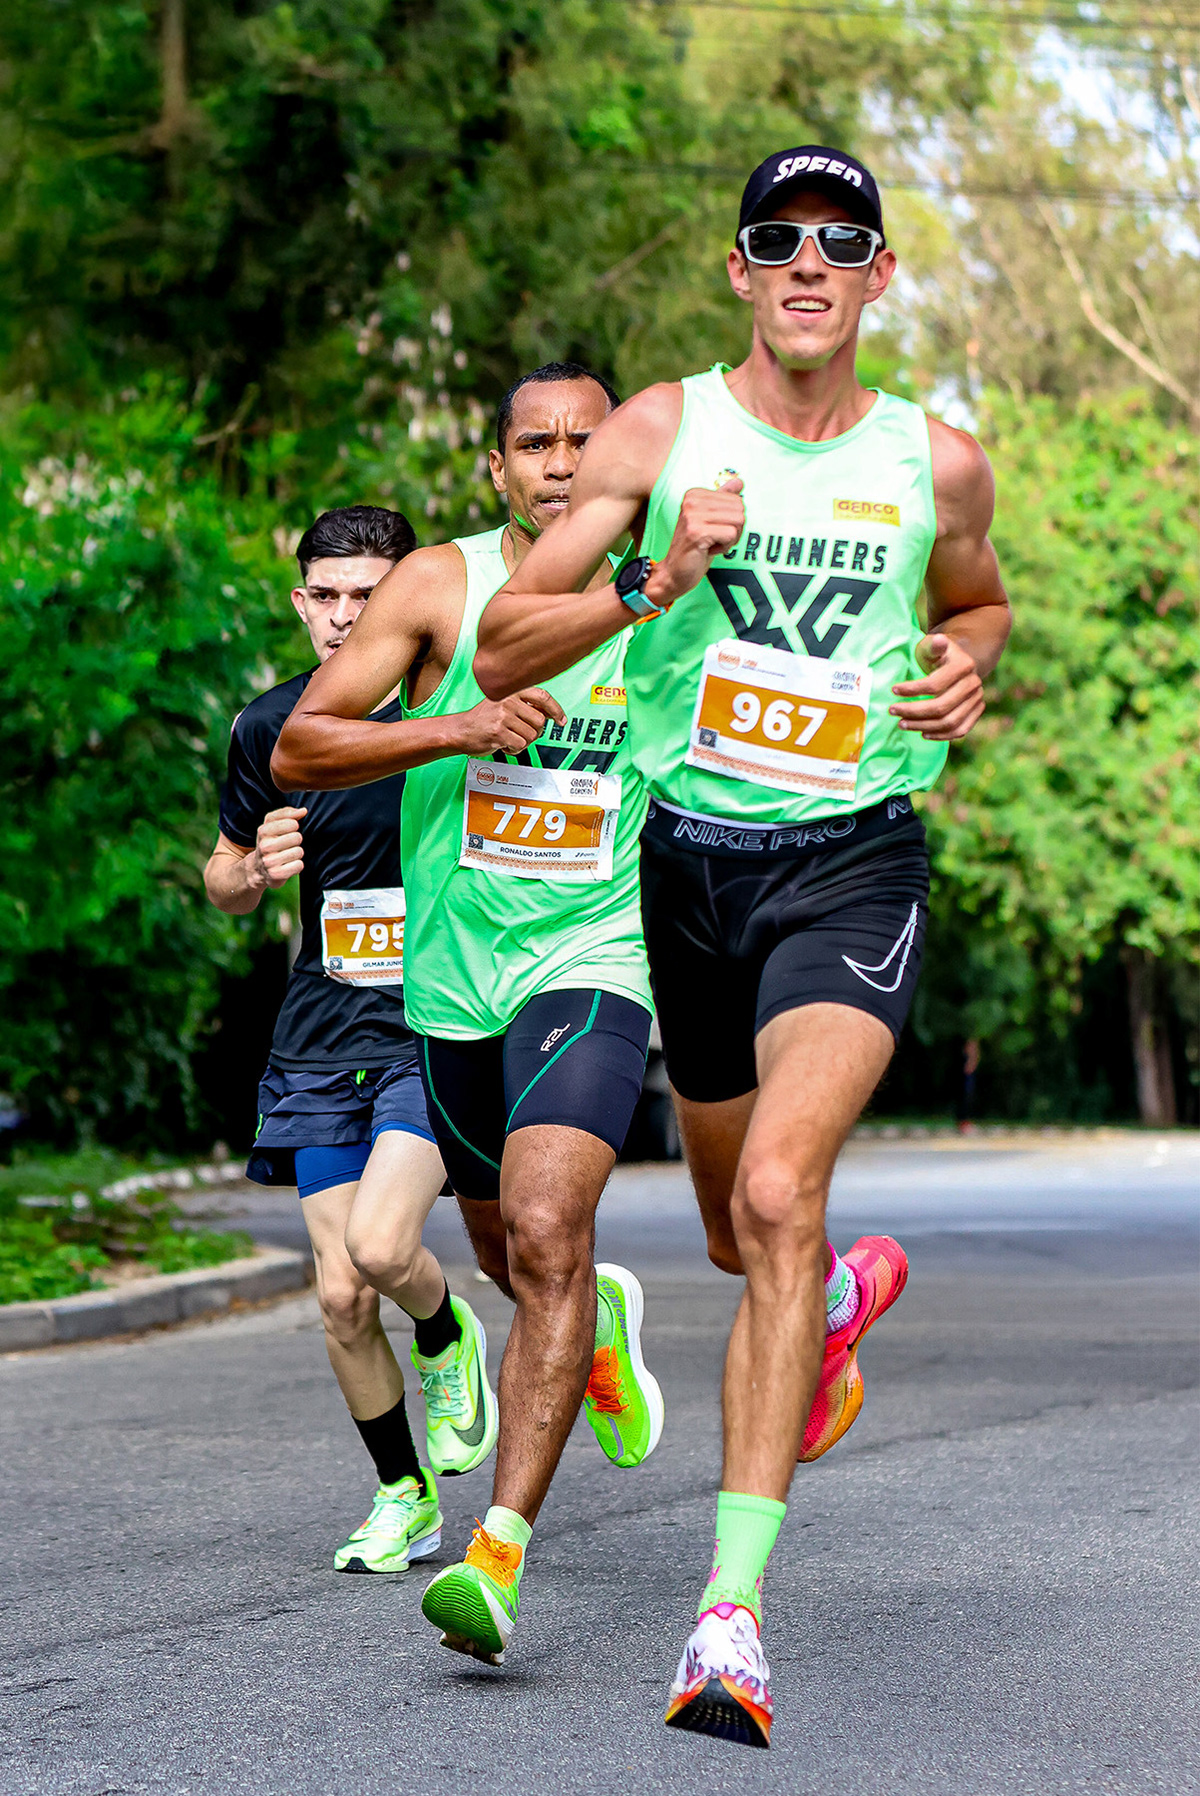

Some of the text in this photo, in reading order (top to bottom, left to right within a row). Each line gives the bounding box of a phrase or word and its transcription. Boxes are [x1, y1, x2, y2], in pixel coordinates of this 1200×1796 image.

[773, 156, 863, 188] SPEED
[838, 500, 894, 515] GENCO
[729, 691, 828, 747] 967
[493, 802, 567, 841] 779
[673, 815, 857, 851] NIKE PRO
[499, 846, 534, 858] RONALDO
[346, 922, 404, 953] 795
